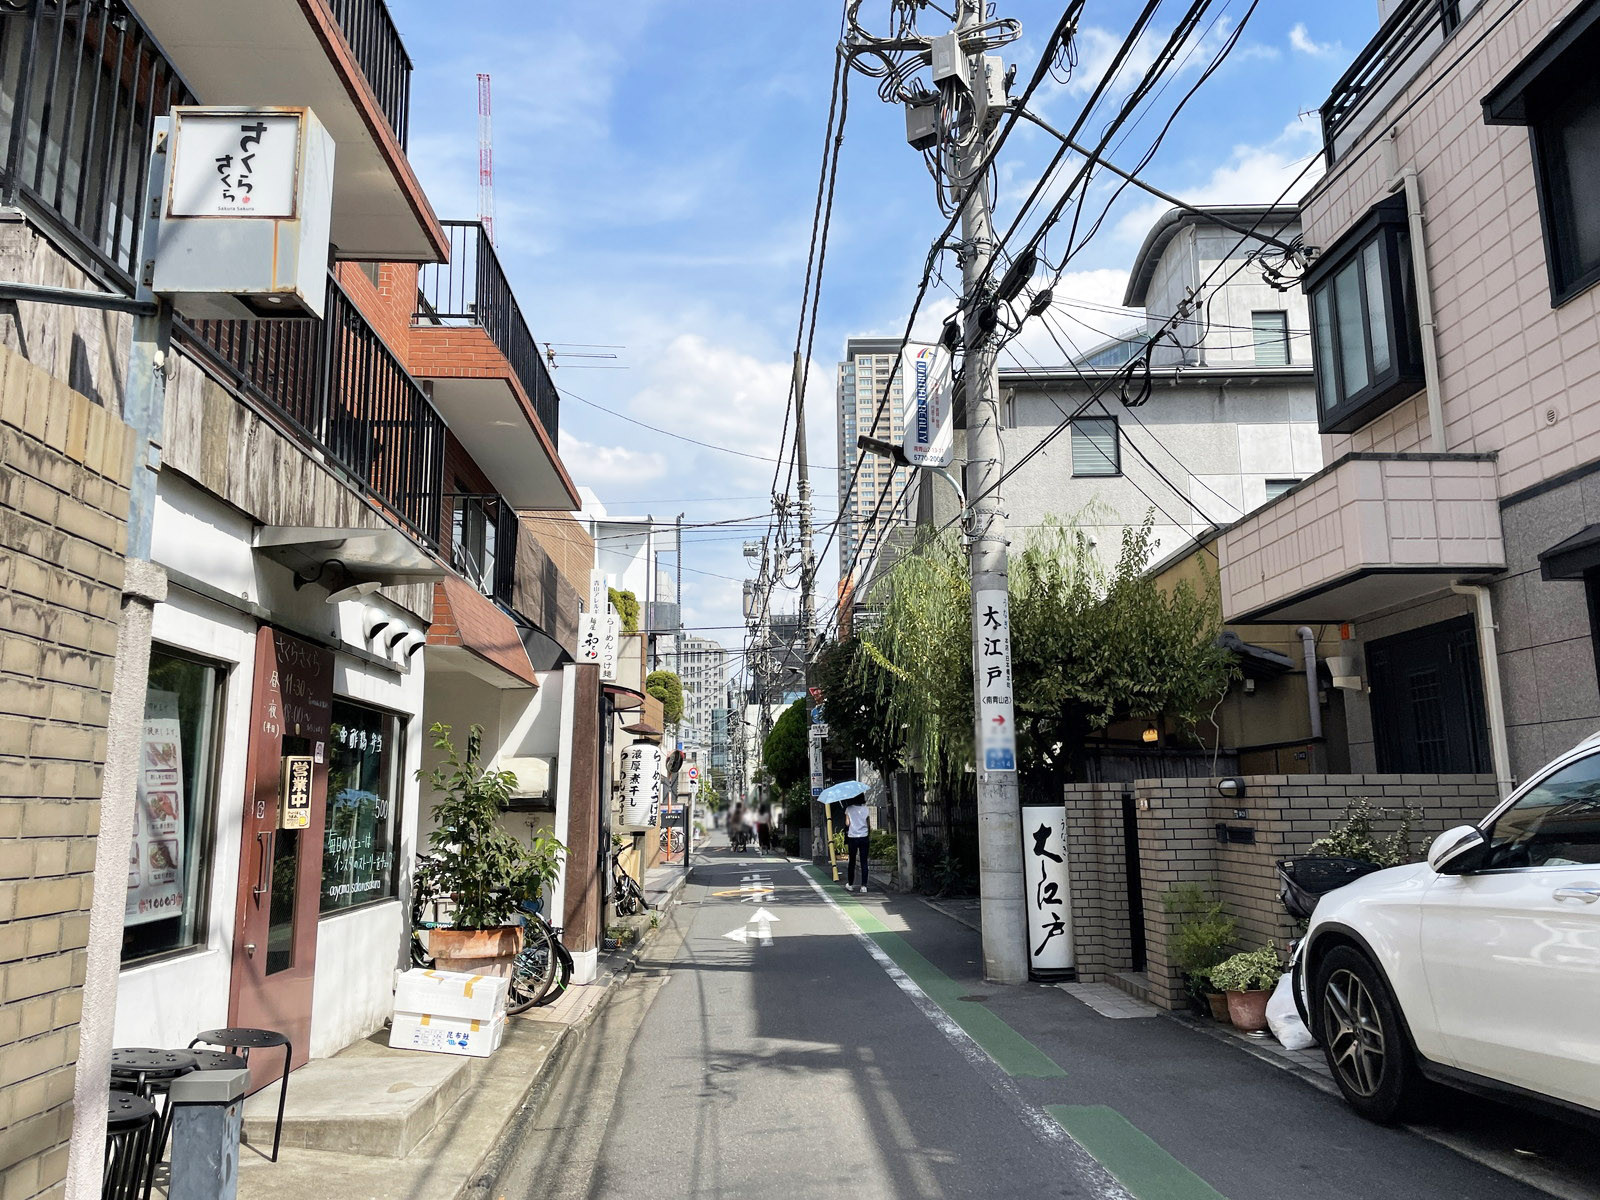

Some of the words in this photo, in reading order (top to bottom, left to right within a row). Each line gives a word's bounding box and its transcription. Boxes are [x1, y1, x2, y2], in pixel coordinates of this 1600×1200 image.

[215, 155, 235, 202] さくら
[238, 122, 267, 193] さくら
[276, 637, 320, 676] さくらさくら
[983, 606, 1003, 688] 大江戸
[292, 761, 309, 808] 営業中
[629, 749, 642, 807] 濃厚煮干し
[1033, 823, 1065, 957] 大江戸
